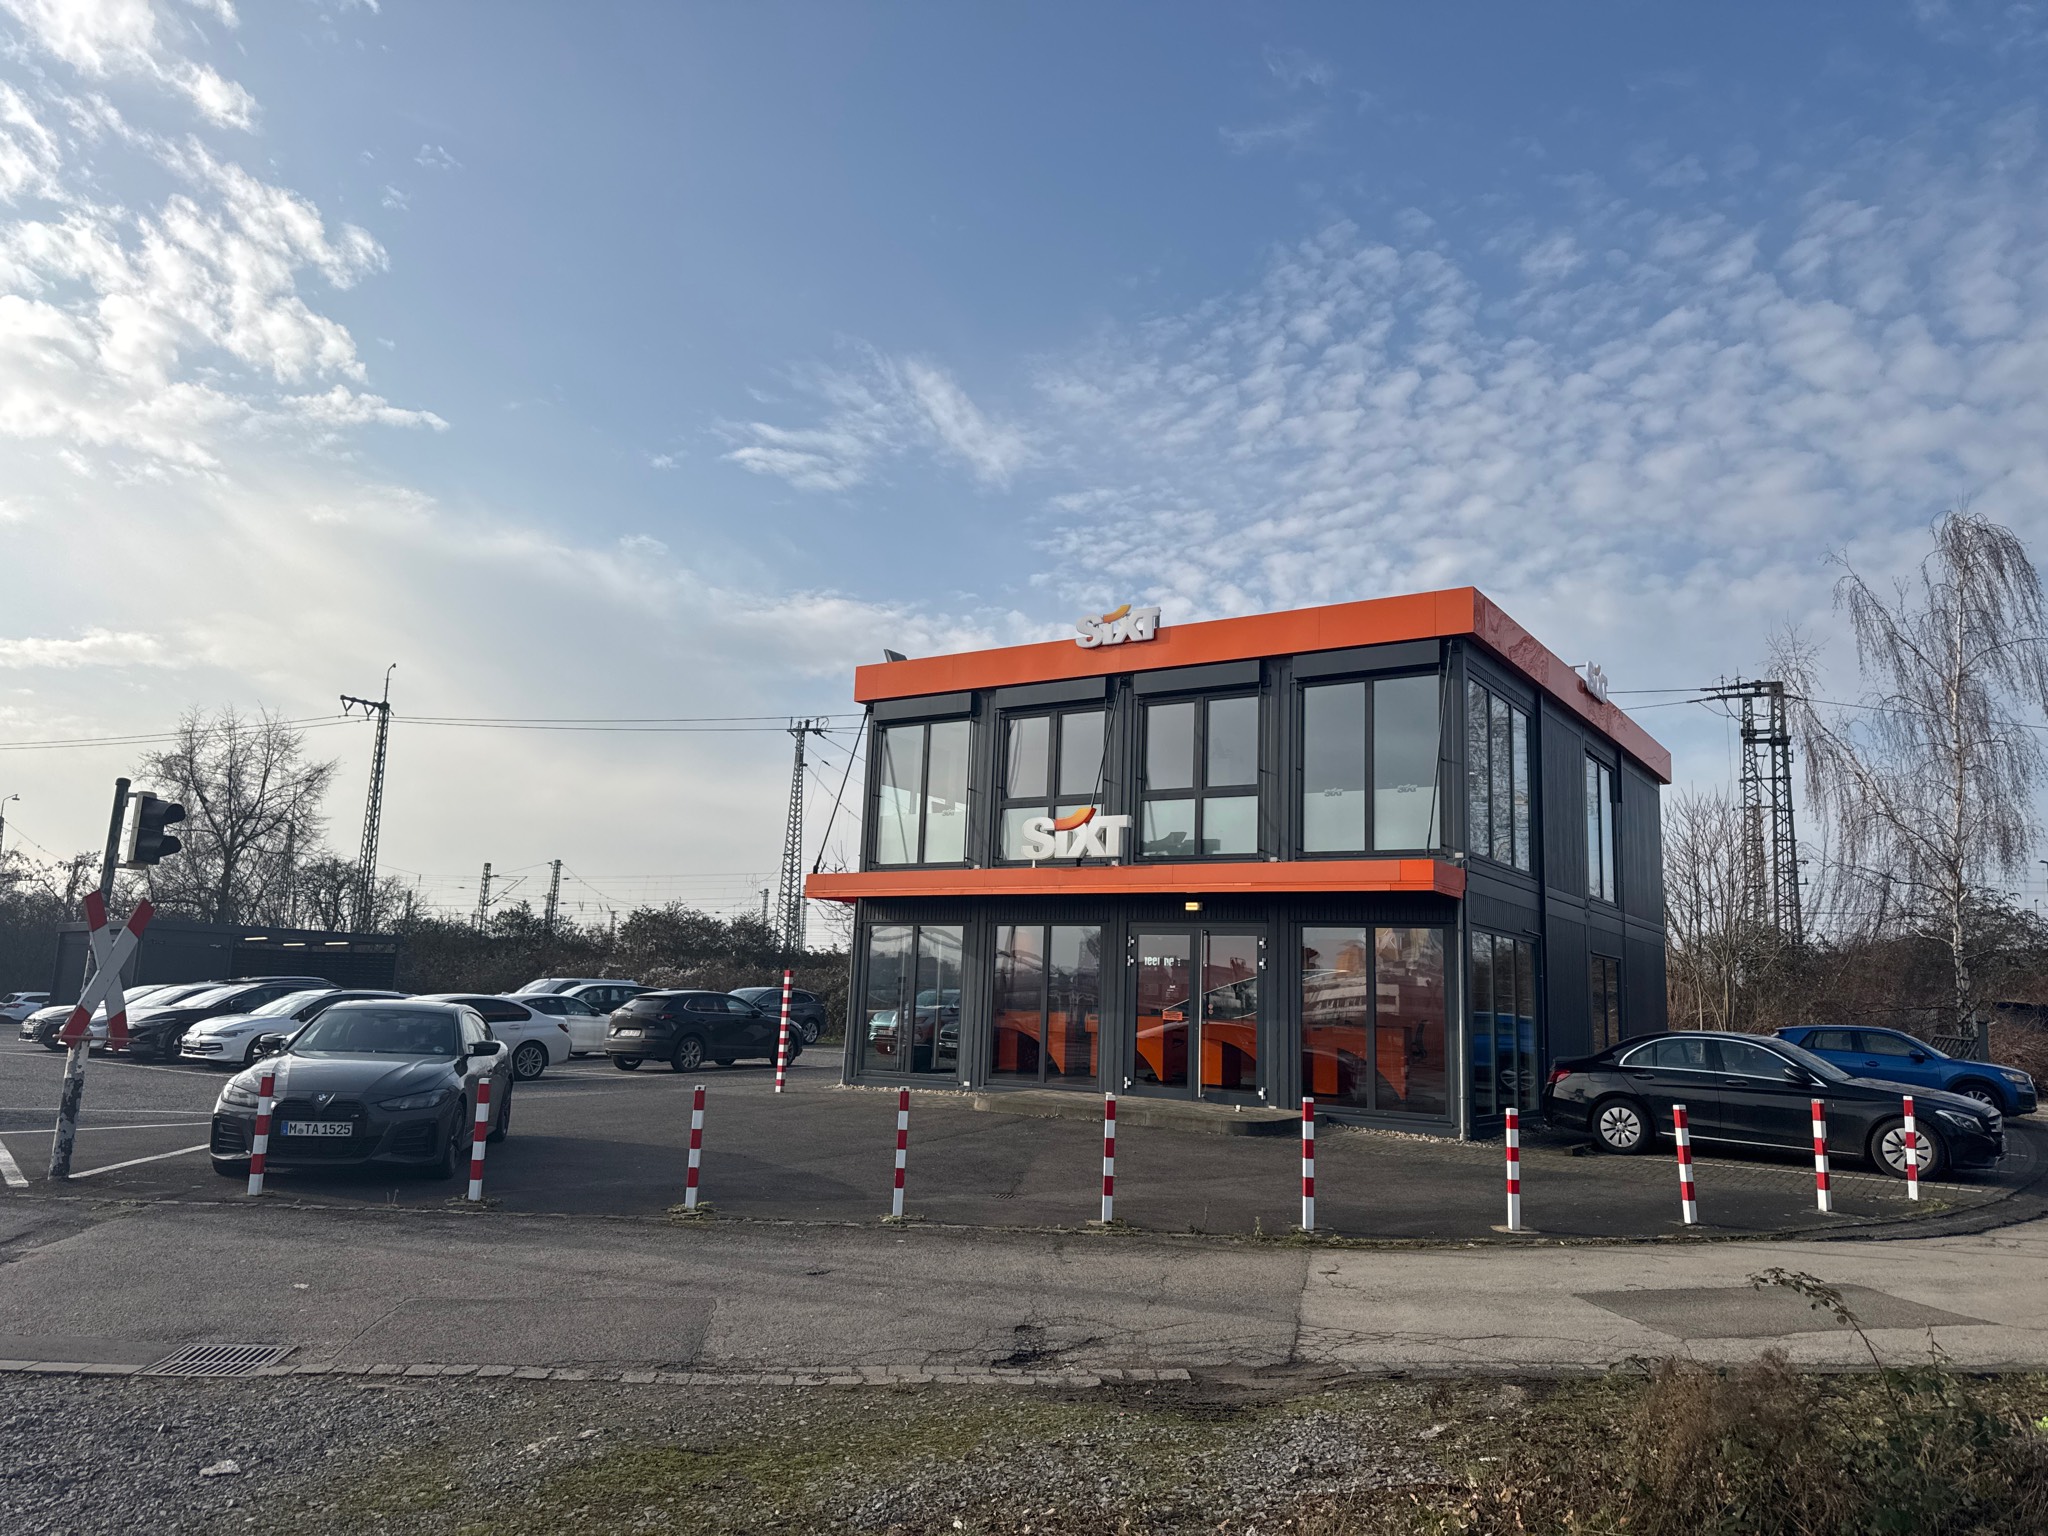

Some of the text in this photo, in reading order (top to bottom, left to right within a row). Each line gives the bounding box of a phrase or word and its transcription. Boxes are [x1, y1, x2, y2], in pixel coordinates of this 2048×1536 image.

[289, 1123, 351, 1135] M TA 1525
